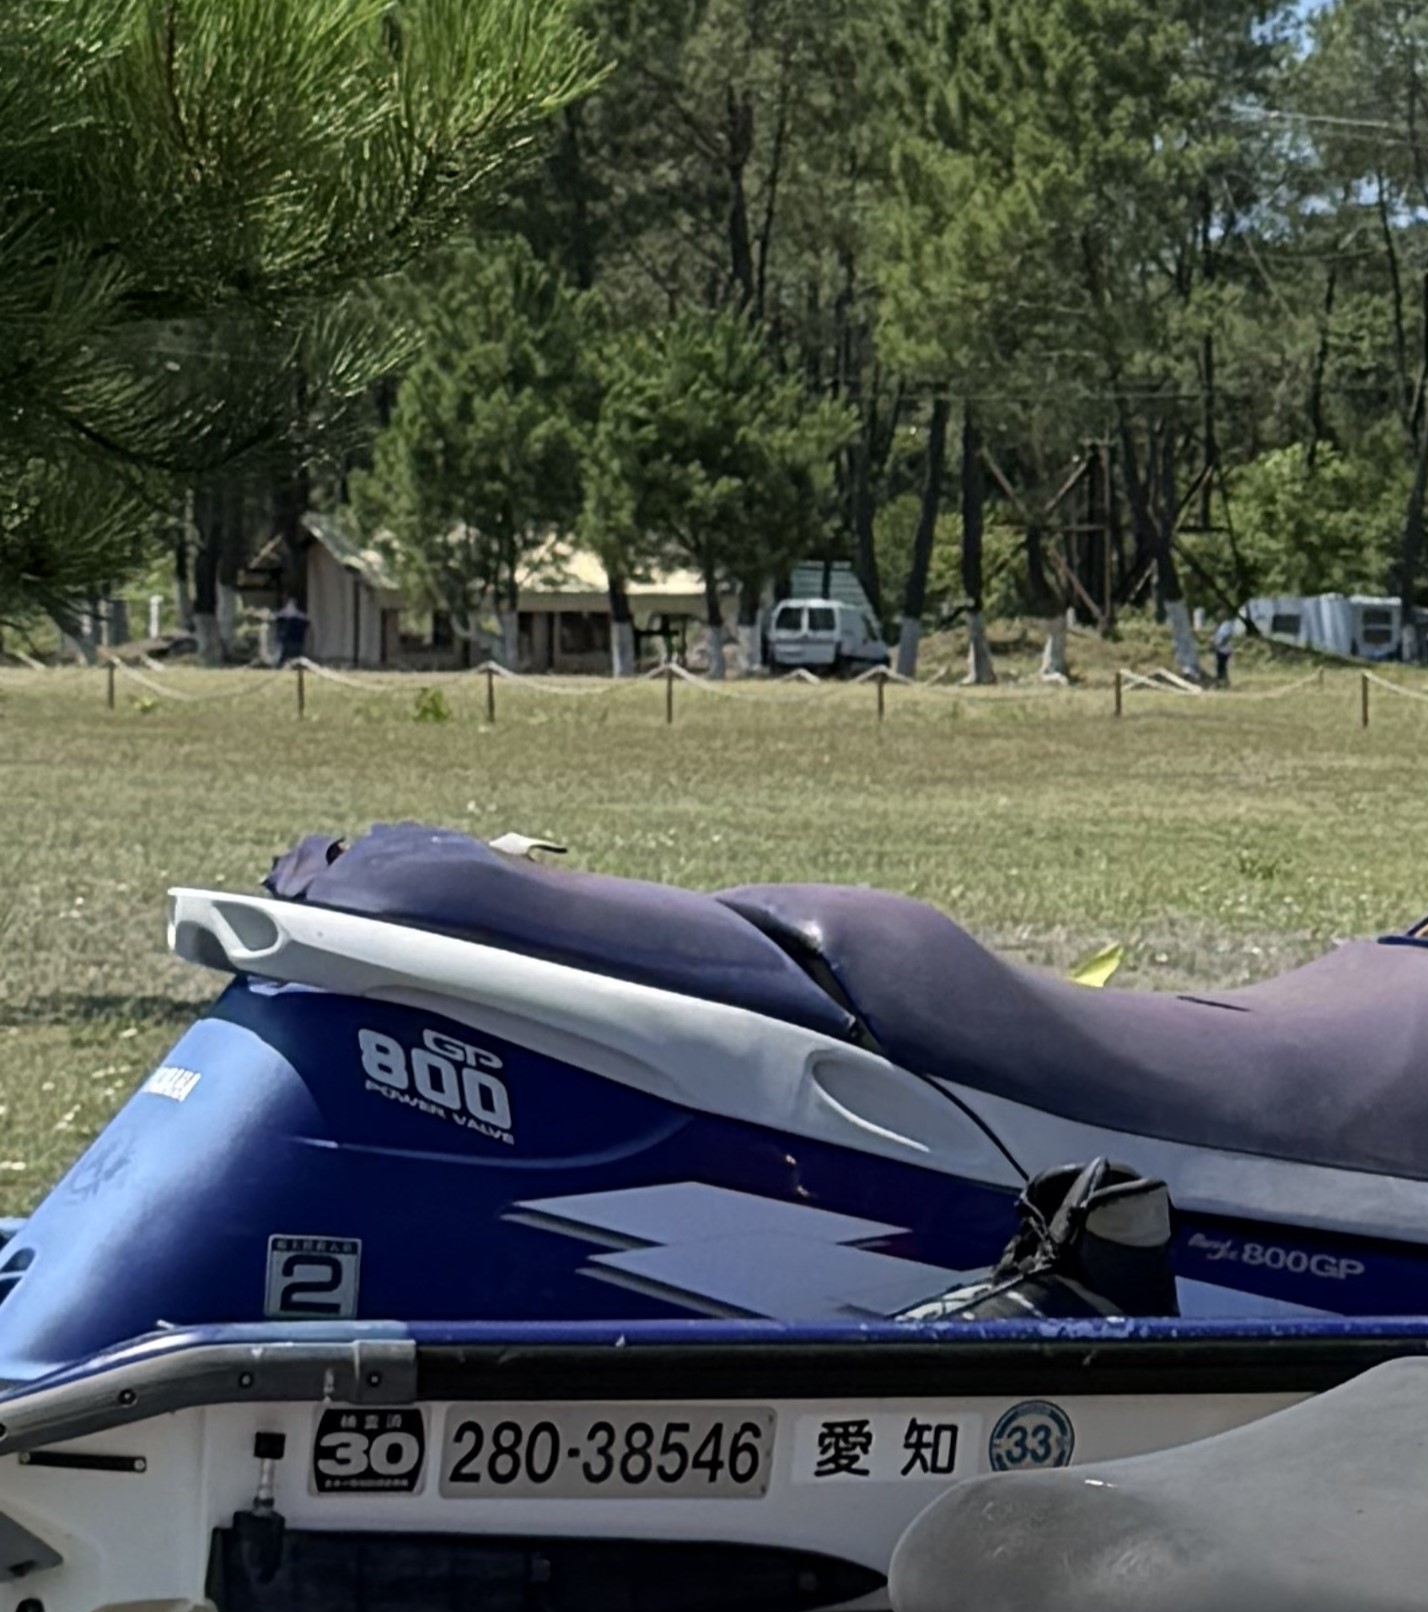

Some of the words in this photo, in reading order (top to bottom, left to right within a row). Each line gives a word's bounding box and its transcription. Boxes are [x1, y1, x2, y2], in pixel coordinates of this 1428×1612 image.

[423, 1028, 503, 1069] GP
[358, 1028, 512, 1130] 800
[365, 1079, 447, 1119] POWER
[452, 1112, 515, 1145] VALVE
[280, 1254, 343, 1313] 2
[1242, 1242, 1365, 1279] 800GP
[318, 1432, 419, 1476] 30
[449, 1420, 762, 1485] 280-38546
[1006, 1424, 1053, 1465] 33
